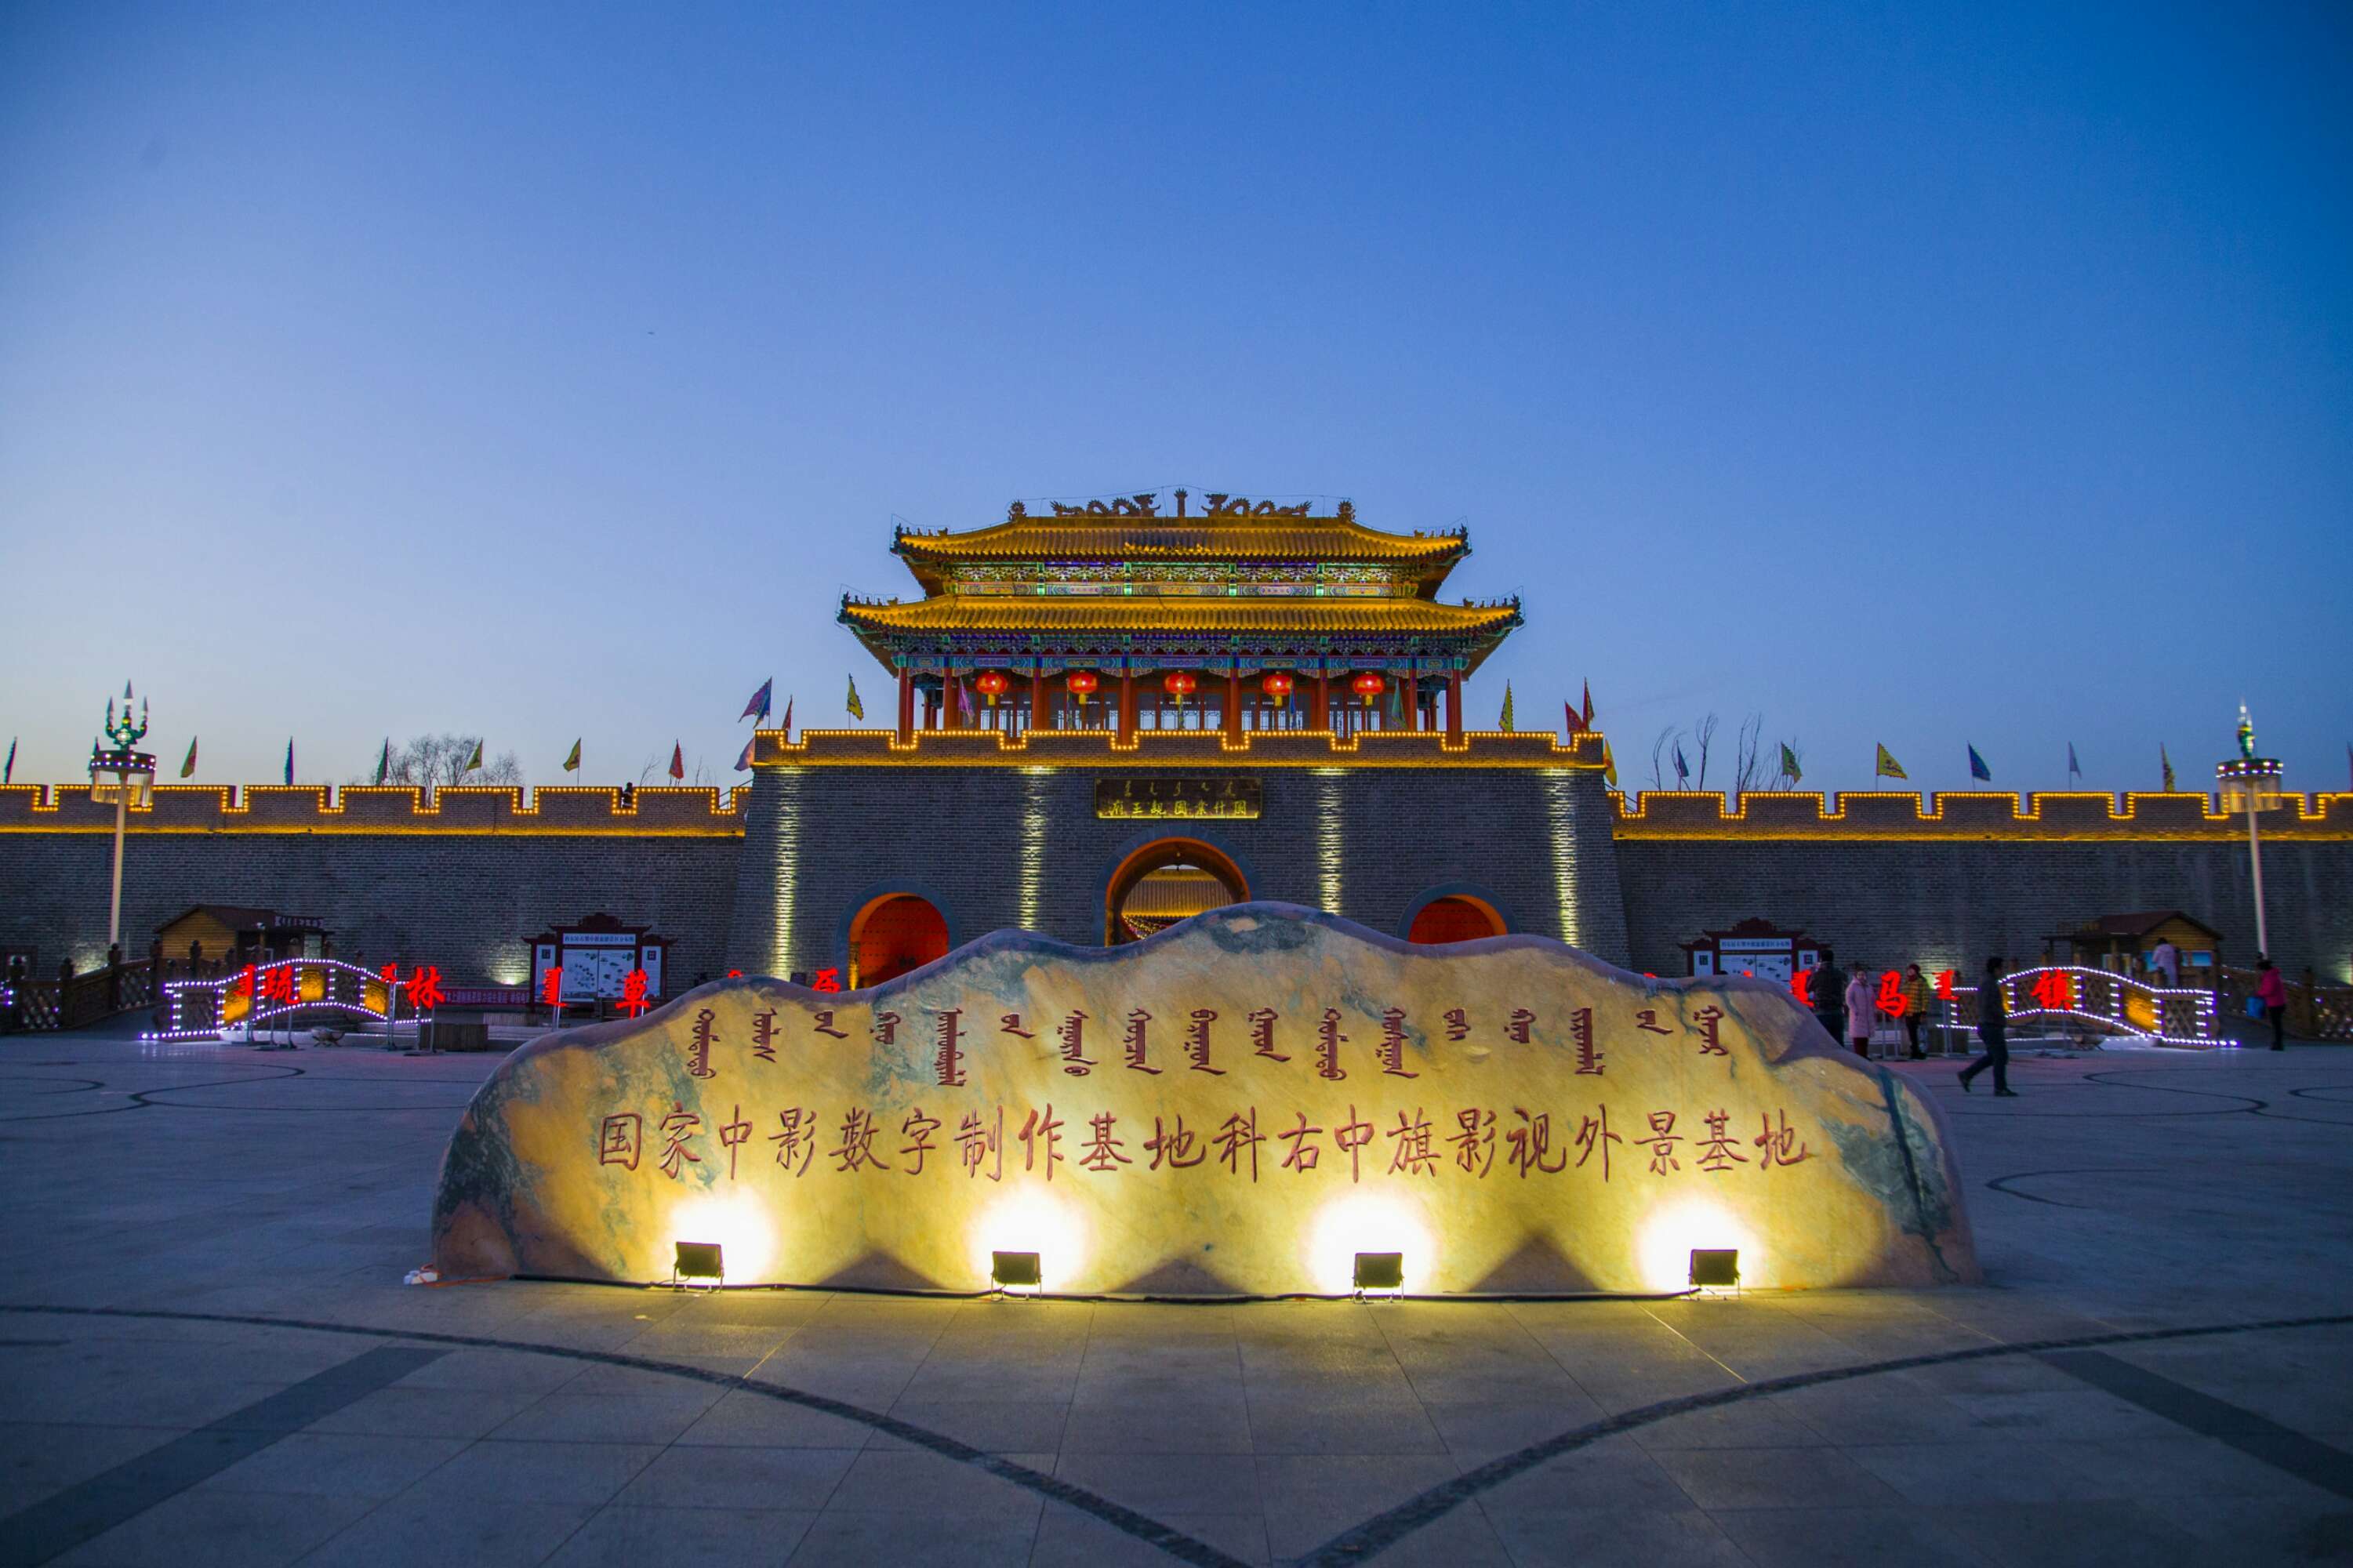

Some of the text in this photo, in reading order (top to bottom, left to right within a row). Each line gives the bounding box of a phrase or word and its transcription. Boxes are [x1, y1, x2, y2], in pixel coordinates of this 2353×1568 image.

[405, 965, 445, 1009] 林
[615, 968, 650, 1019] 草
[1875, 971, 1912, 1018] 马
[598, 1102, 1807, 1183] 国家中影数字制作基地科右中旗影视外景基地
